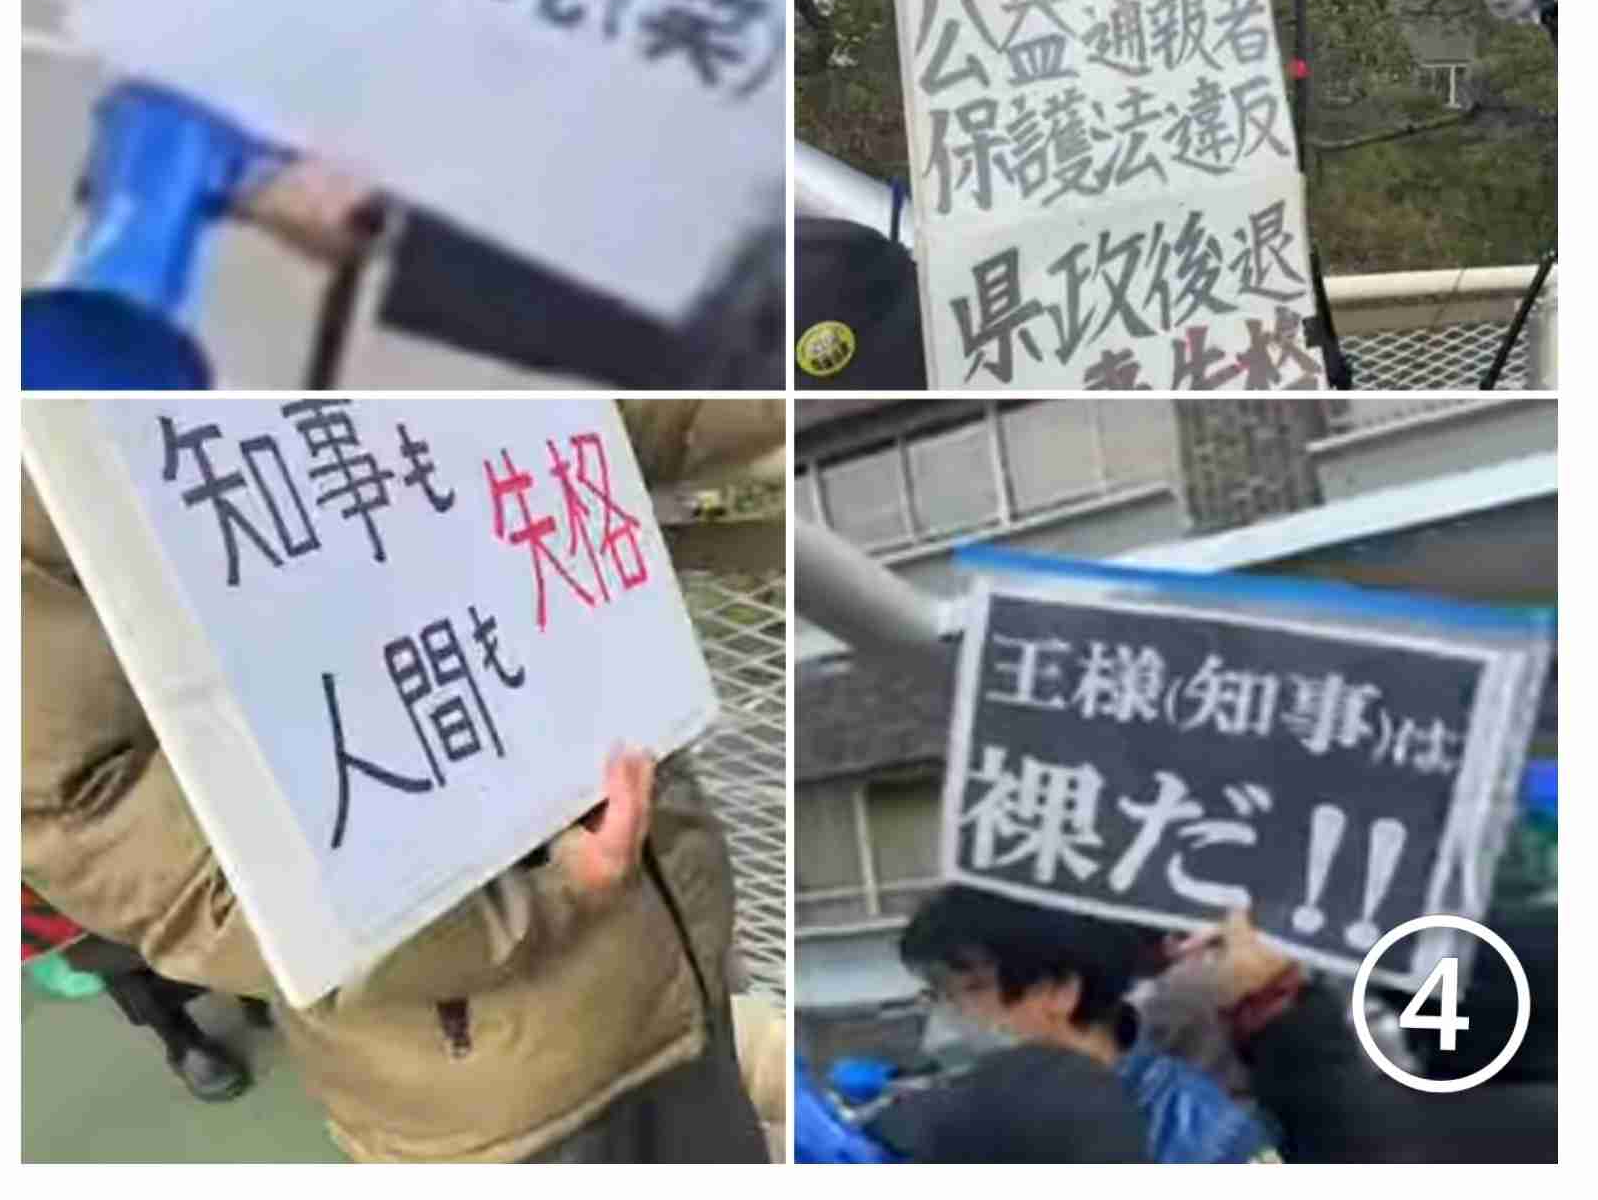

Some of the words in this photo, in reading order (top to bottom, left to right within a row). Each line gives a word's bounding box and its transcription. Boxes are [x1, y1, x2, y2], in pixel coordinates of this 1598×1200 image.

[923, 76, 1292, 215] 保護法違反
[948, 200, 1307, 384] 県政後退
[157, 399, 455, 587] 知事も
[483, 430, 649, 633] 失格
[322, 604, 527, 850] 人間も
